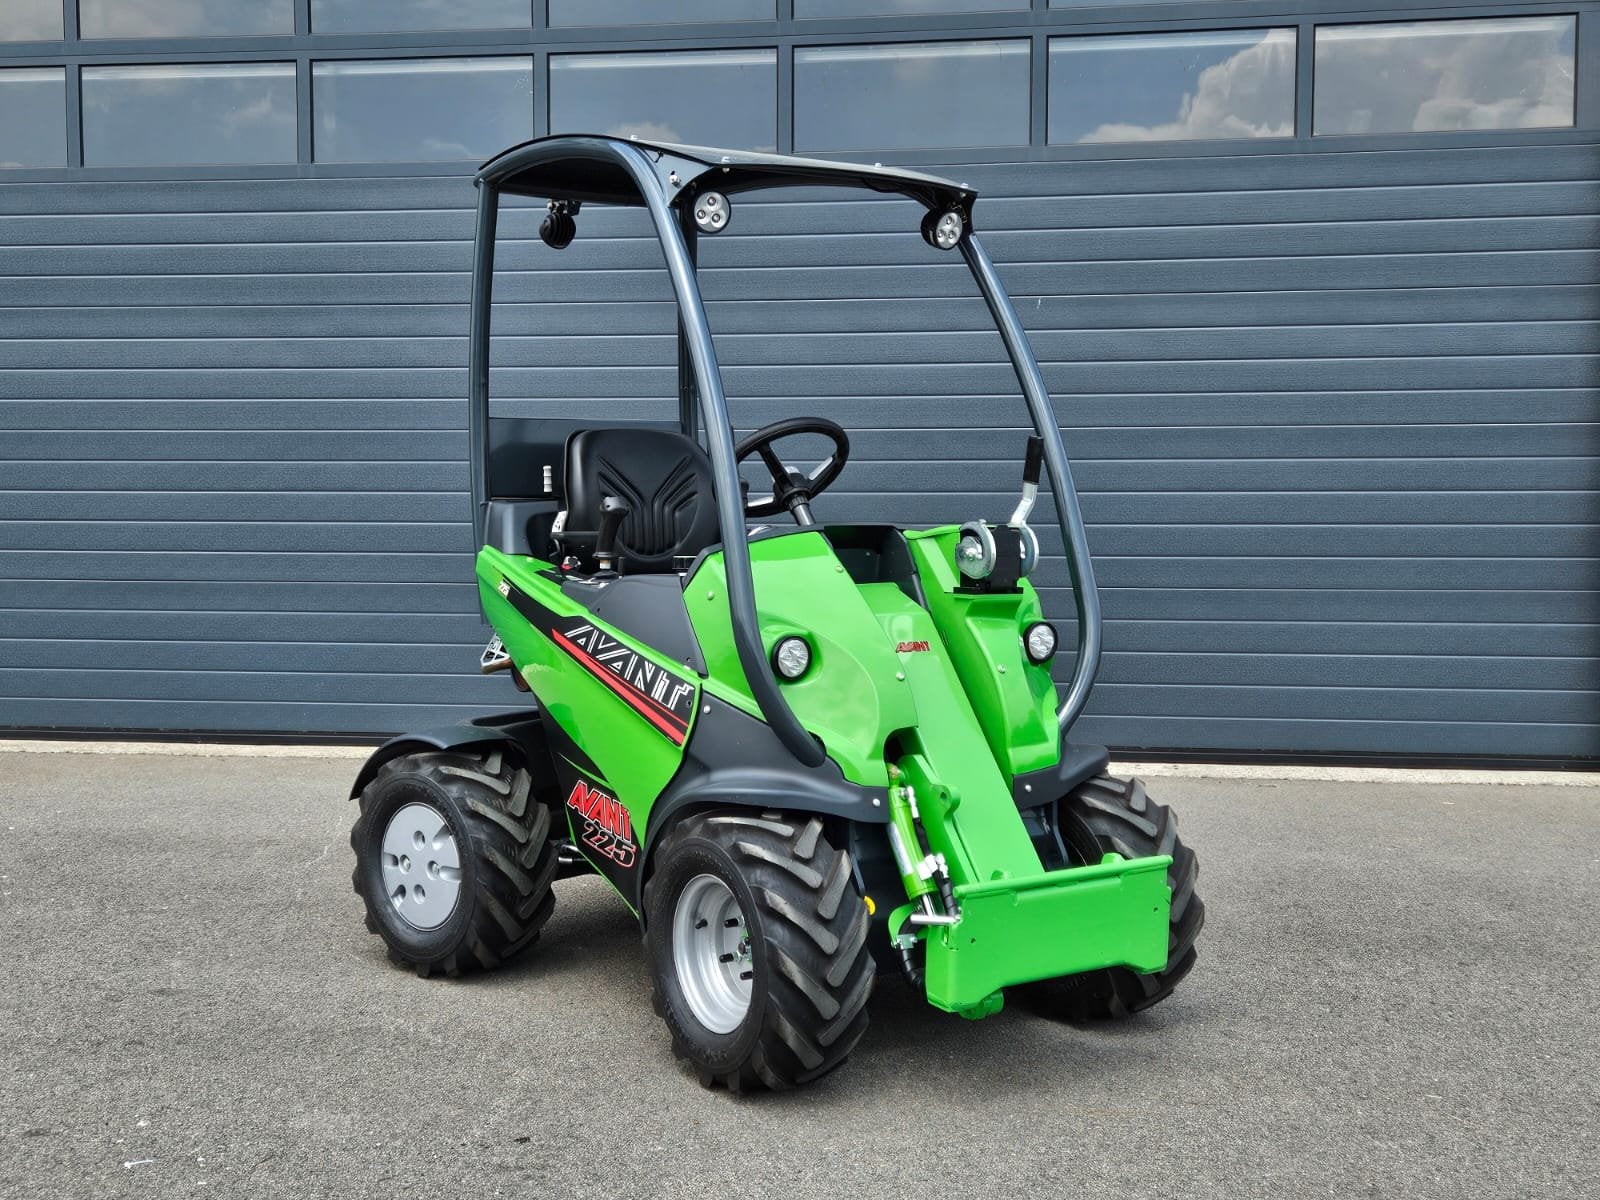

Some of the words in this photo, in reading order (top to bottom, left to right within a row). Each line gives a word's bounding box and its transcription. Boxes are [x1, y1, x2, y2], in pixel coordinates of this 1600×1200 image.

[564, 625, 694, 710] AVANT
[567, 780, 631, 843] AVANT
[582, 821, 637, 867] 225
